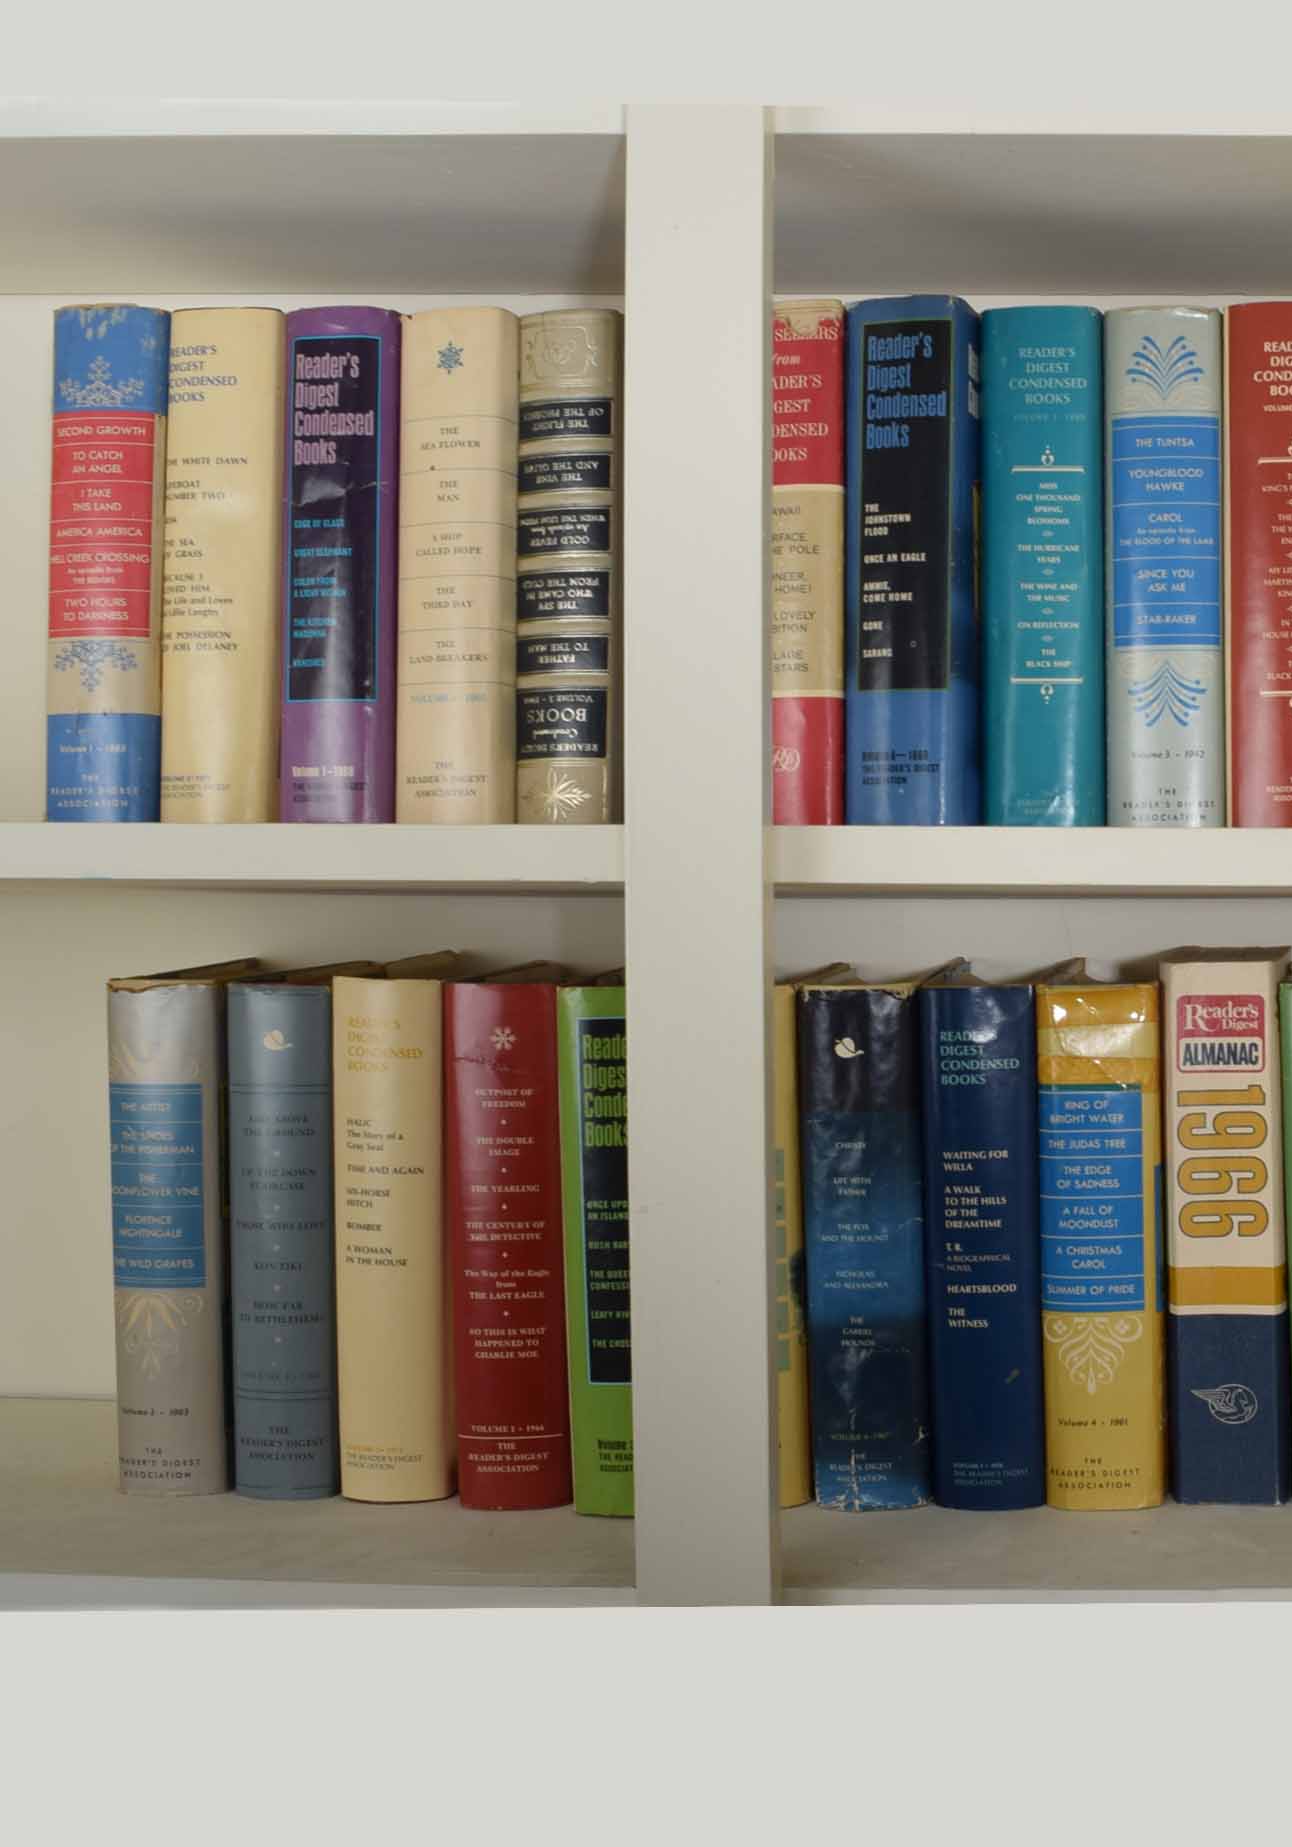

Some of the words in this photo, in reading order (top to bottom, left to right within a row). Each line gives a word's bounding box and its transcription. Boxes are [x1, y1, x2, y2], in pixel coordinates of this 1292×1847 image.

[868, 332, 933, 362] Reader's
[296, 352, 359, 379] Reader's
[1027, 363, 1070, 372] DIGEST
[867, 363, 911, 391] Digest
[1009, 378, 1087, 389] CONDENSED
[296, 382, 338, 410] Digest
[1025, 393, 1071, 404] BOOKS
[867, 391, 946, 419] Condensed
[295, 411, 374, 436] Condensed
[96, 425, 145, 436] GROWTH
[866, 425, 909, 449] Books
[1136, 439, 1153, 447] THE
[89, 451, 123, 461] CATCH
[295, 440, 336, 465] Books
[216, 457, 247, 465] DAWN
[1129, 469, 1203, 478] YOUNGBLOOD
[1147, 482, 1185, 491] HAWKE
[93, 502, 122, 511] LAND
[1148, 514, 1183, 523] CAROL
[97, 528, 142, 536] AMERICA
[865, 527, 888, 536] FLOOD
[864, 554, 886, 563] ONCE
[889, 554, 899, 562] AN
[901, 553, 926, 562] EAGLE
[1137, 569, 1166, 578] SINCE
[1171, 569, 1194, 578] YOU
[1148, 583, 1168, 592] ASK
[1171, 583, 1186, 591] ME
[1183, 1001, 1258, 1031] Reader's
[1222, 1018, 1258, 1031] Digest
[941, 1045, 984, 1057] DIGEST
[1183, 1042, 1259, 1066] ALMANAC
[941, 1058, 1019, 1070] CONDENSED
[941, 1074, 985, 1085] BOOKS
[1050, 1114, 1085, 1124] BRIGHT
[1089, 1113, 1124, 1122] WATER
[1049, 1140, 1066, 1149] THE
[1070, 1139, 1100, 1148] JUDAS
[1105, 1138, 1126, 1148] TREE
[944, 1151, 983, 1160] WAITING
[986, 1150, 1008, 1160] FOR
[1177, 1085, 1268, 1238] 1966
[1059, 1220, 1118, 1229] MOONDUST
[948, 1283, 1016, 1294] HEARTSBLOOD
[1048, 1285, 1087, 1295] SUMMER
[1091, 1285, 1105, 1294] OF
[1108, 1284, 1135, 1294] PRIDE
[949, 1320, 988, 1329] WITNESS
